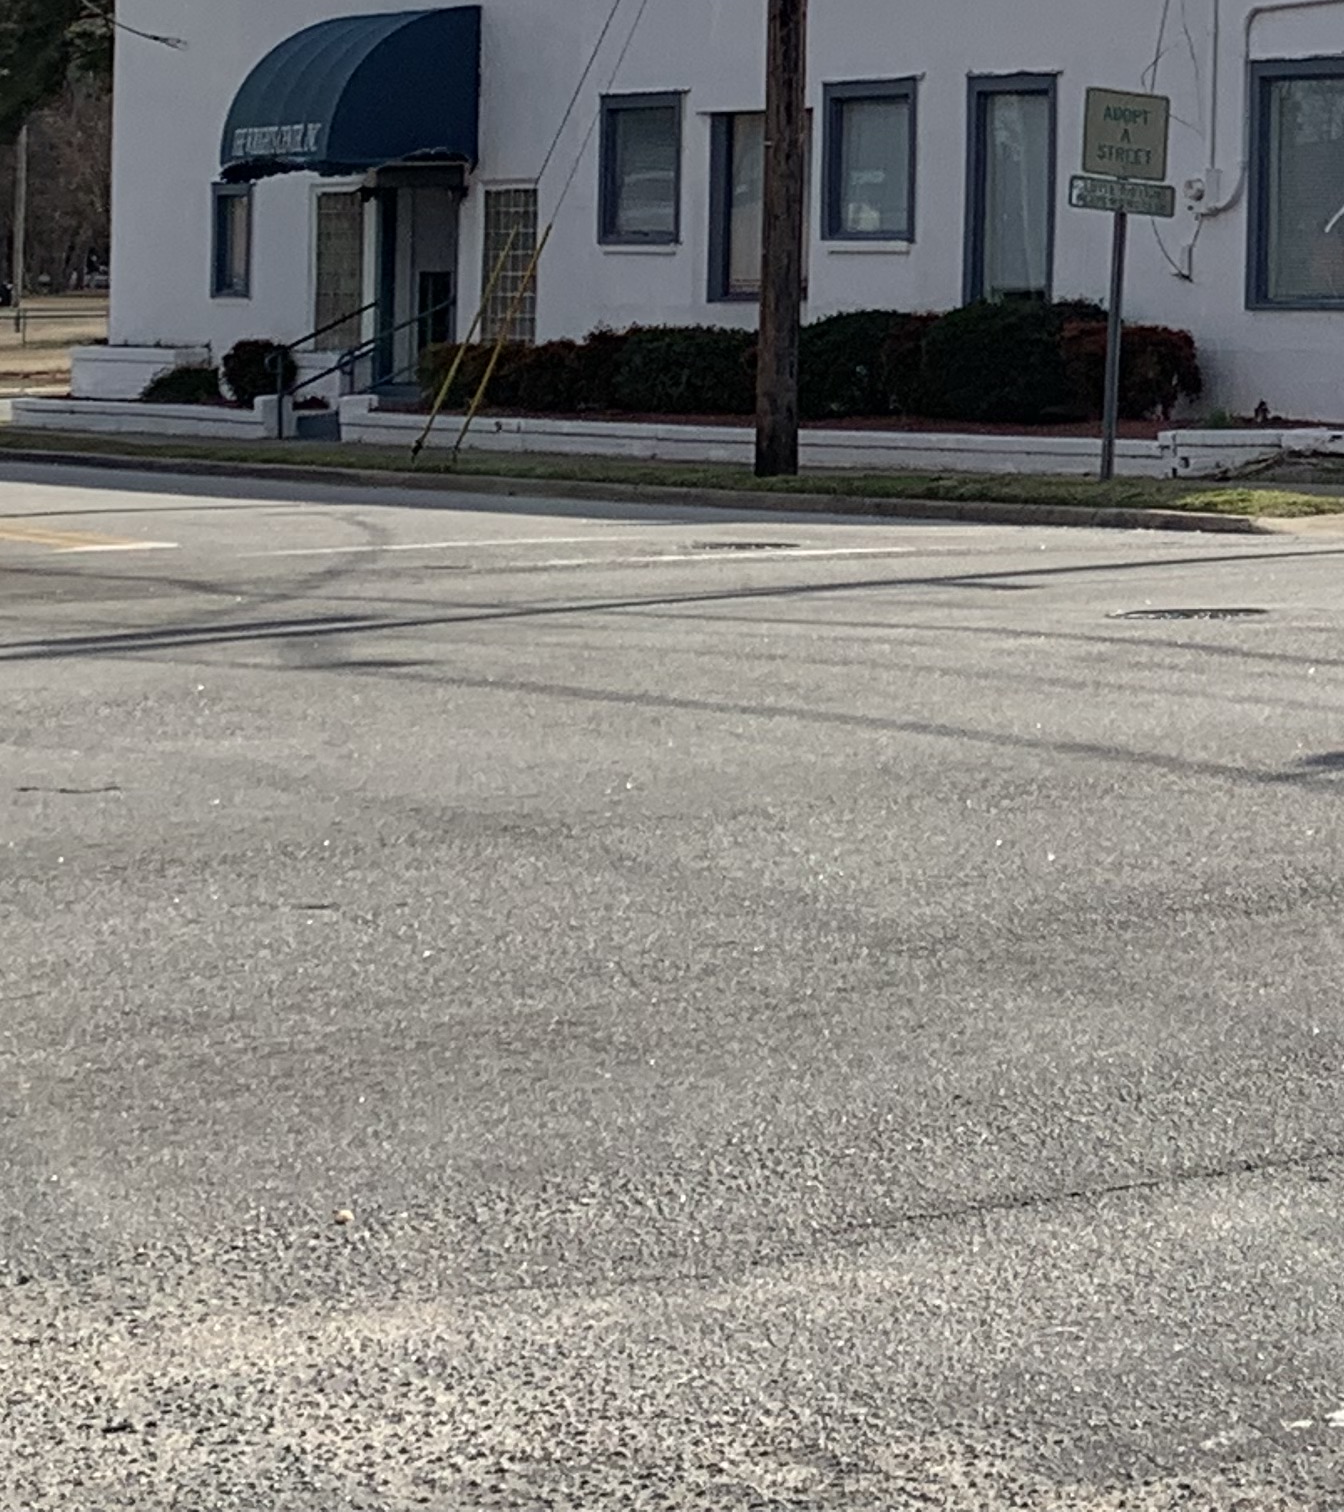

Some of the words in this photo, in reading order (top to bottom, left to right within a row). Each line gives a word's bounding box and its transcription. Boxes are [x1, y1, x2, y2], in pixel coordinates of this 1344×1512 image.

[1103, 104, 1152, 126] ADOPT
[1120, 127, 1132, 144] A
[1097, 143, 1152, 165] STREET
